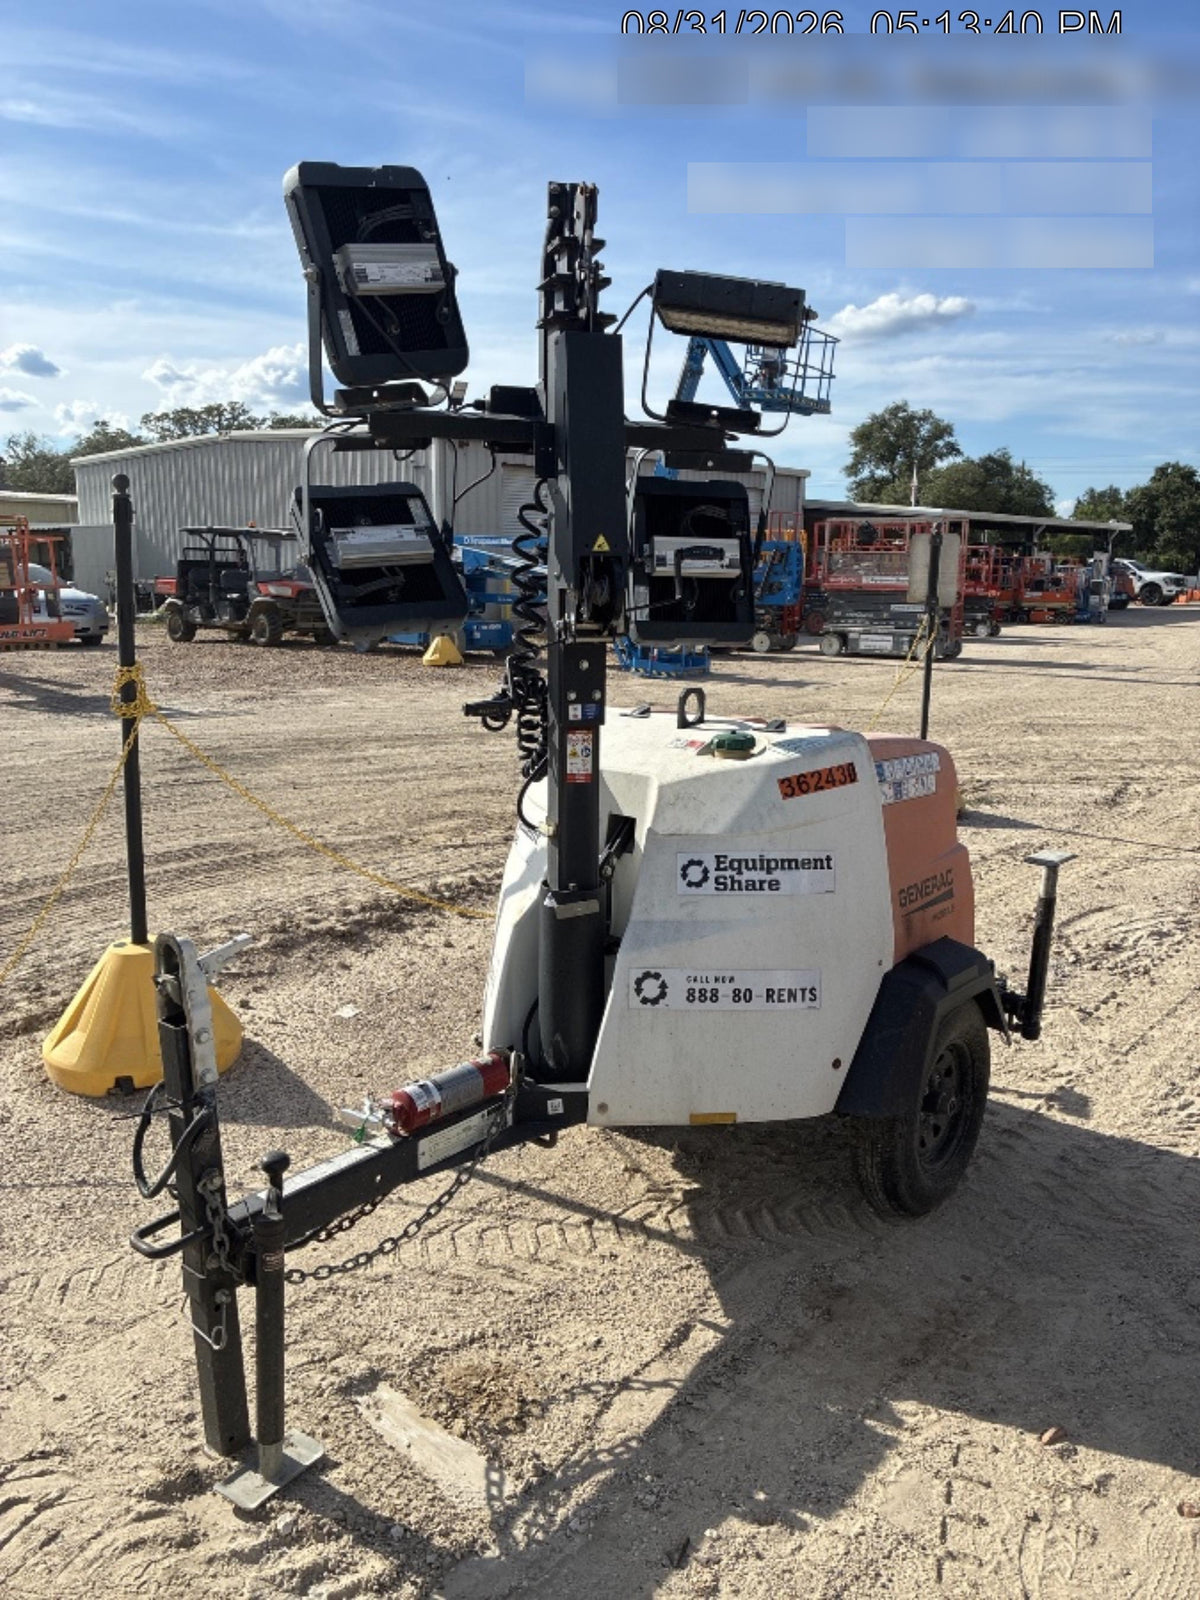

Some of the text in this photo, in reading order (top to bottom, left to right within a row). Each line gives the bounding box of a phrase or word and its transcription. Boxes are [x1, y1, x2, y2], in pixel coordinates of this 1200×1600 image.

[714, 854, 833, 875] Equipment
[714, 876, 781, 892] Share
[898, 868, 954, 907] GENERAC
[686, 975, 735, 984] CALL NOW
